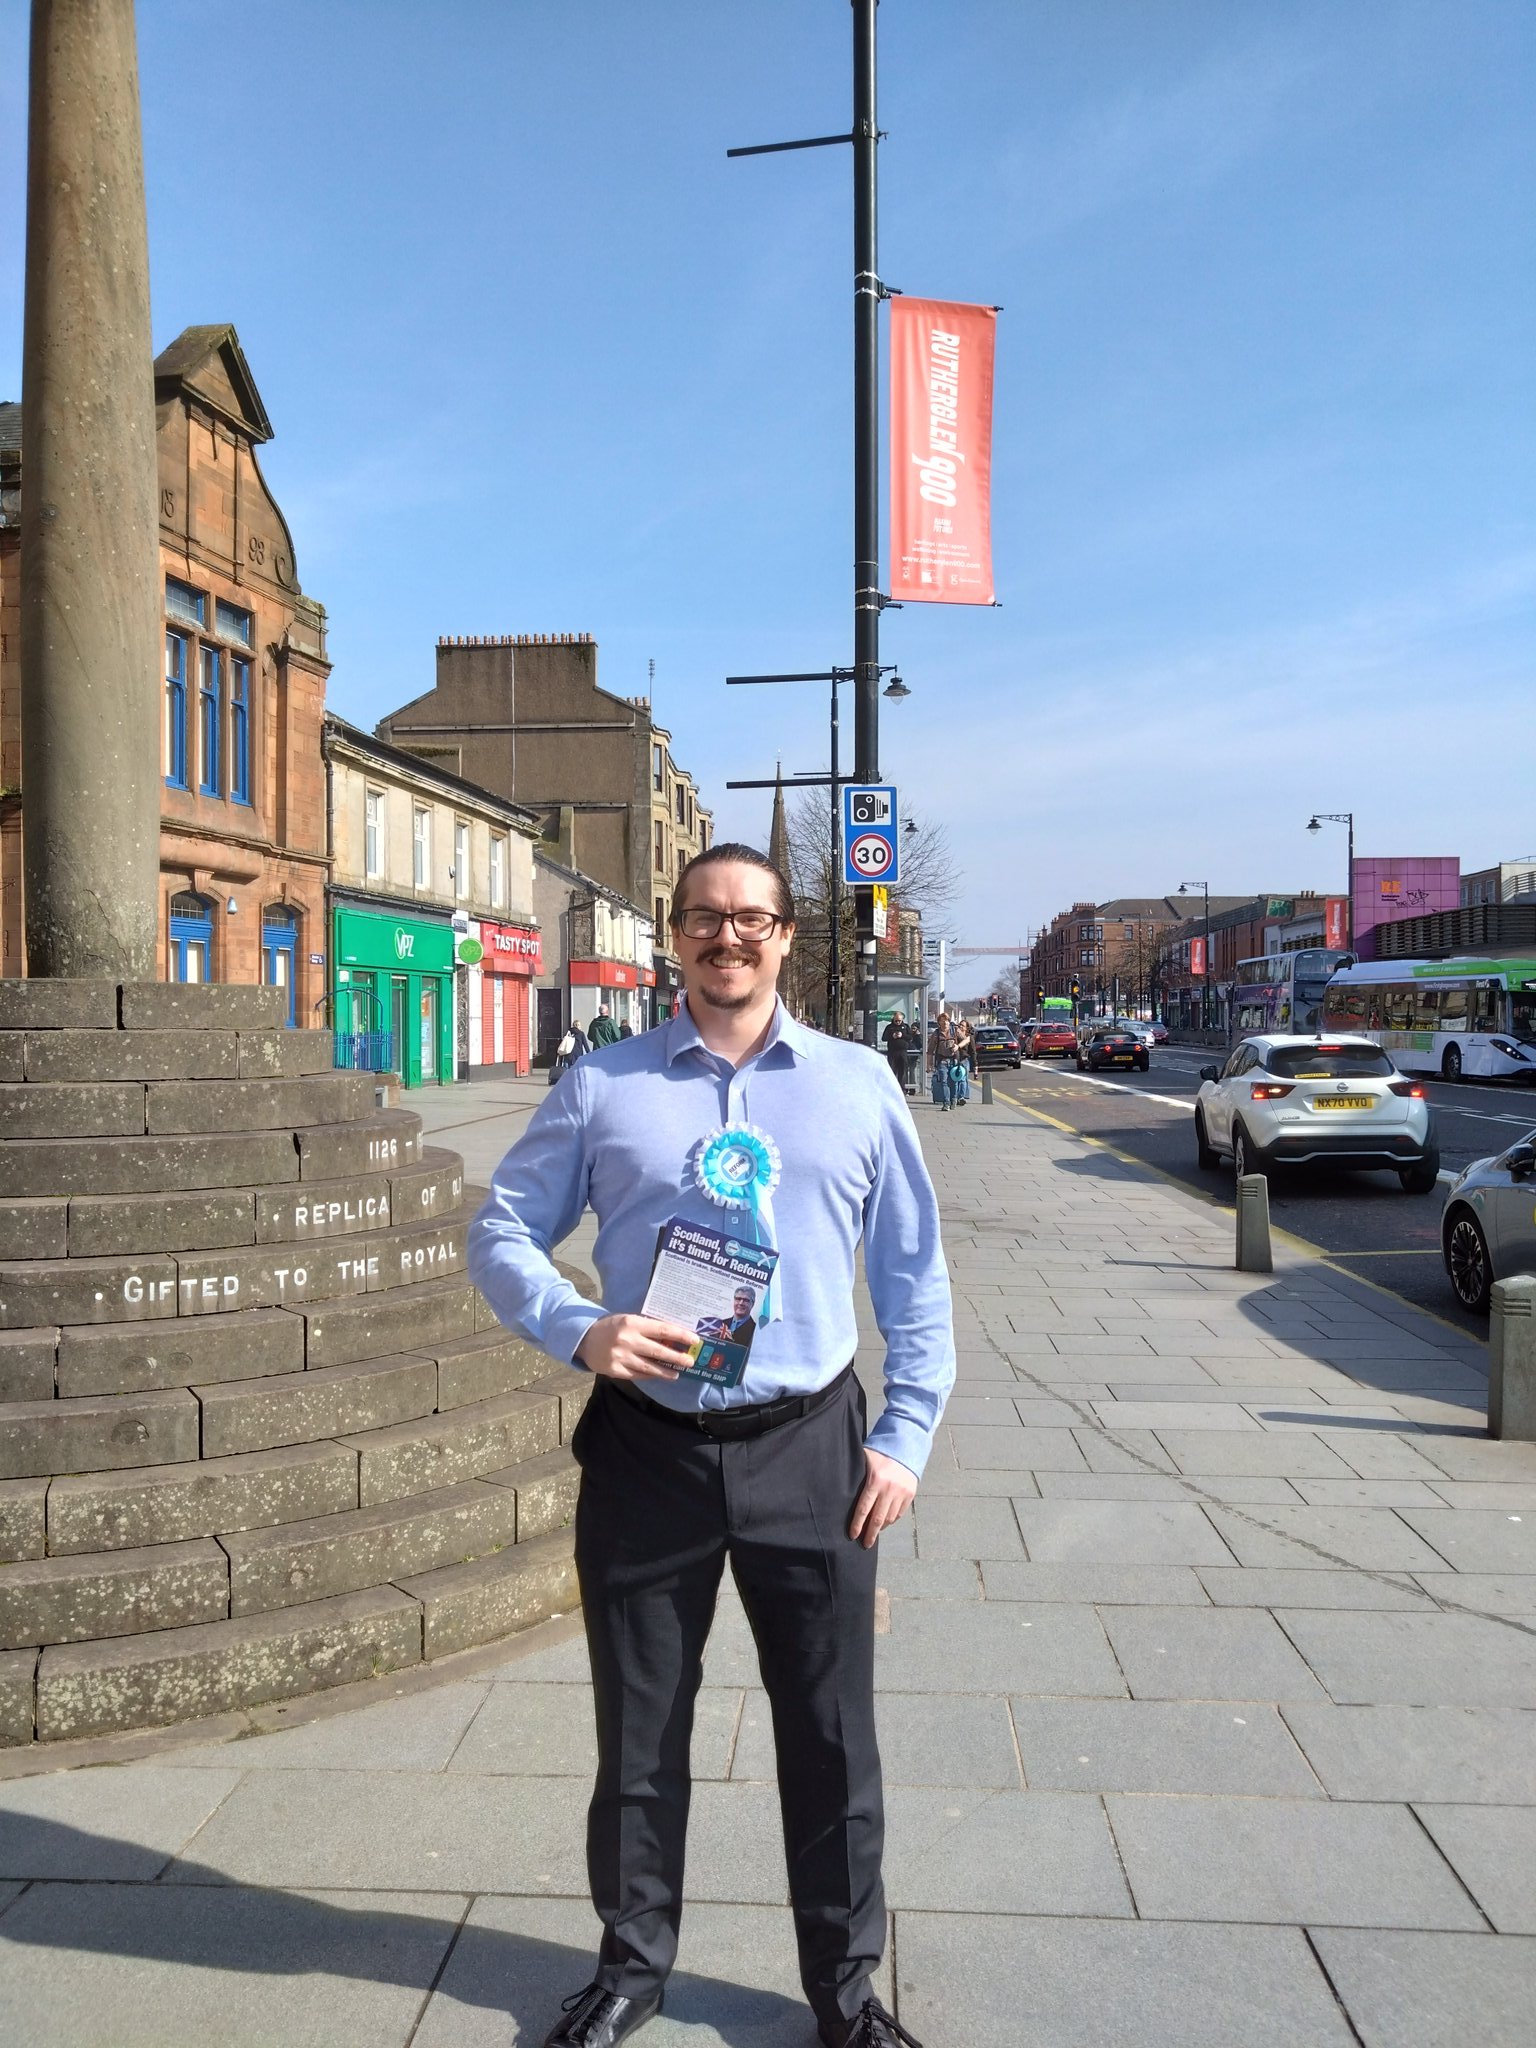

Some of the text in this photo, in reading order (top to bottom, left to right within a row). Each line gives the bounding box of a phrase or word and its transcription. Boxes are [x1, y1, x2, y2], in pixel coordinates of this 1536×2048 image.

[930, 329, 962, 459] RUTHERGLEN
[912, 453, 957, 507] 900
[248, 537, 265, 566] 93
[857, 847, 886, 864] 30
[395, 930, 414, 958] VPZ
[494, 934, 540, 955] TASTY SPOT
[1318, 1097, 1345, 1108] NX70
[369, 1138, 398, 1160] 1126
[729, 1158, 746, 1174] REFORM
[295, 1196, 389, 1227] REPLICA
[421, 1186, 437, 1206] OF
[672, 1225, 721, 1253] Scotland,
[124, 1241, 457, 1303] GIFTED TO THE ROYAL
[668, 1237, 686, 1252] it's
[687, 1244, 712, 1261] time
[713, 1252, 729, 1267] for
[730, 1258, 769, 1281] Reform
[701, 1370, 712, 1378] the
